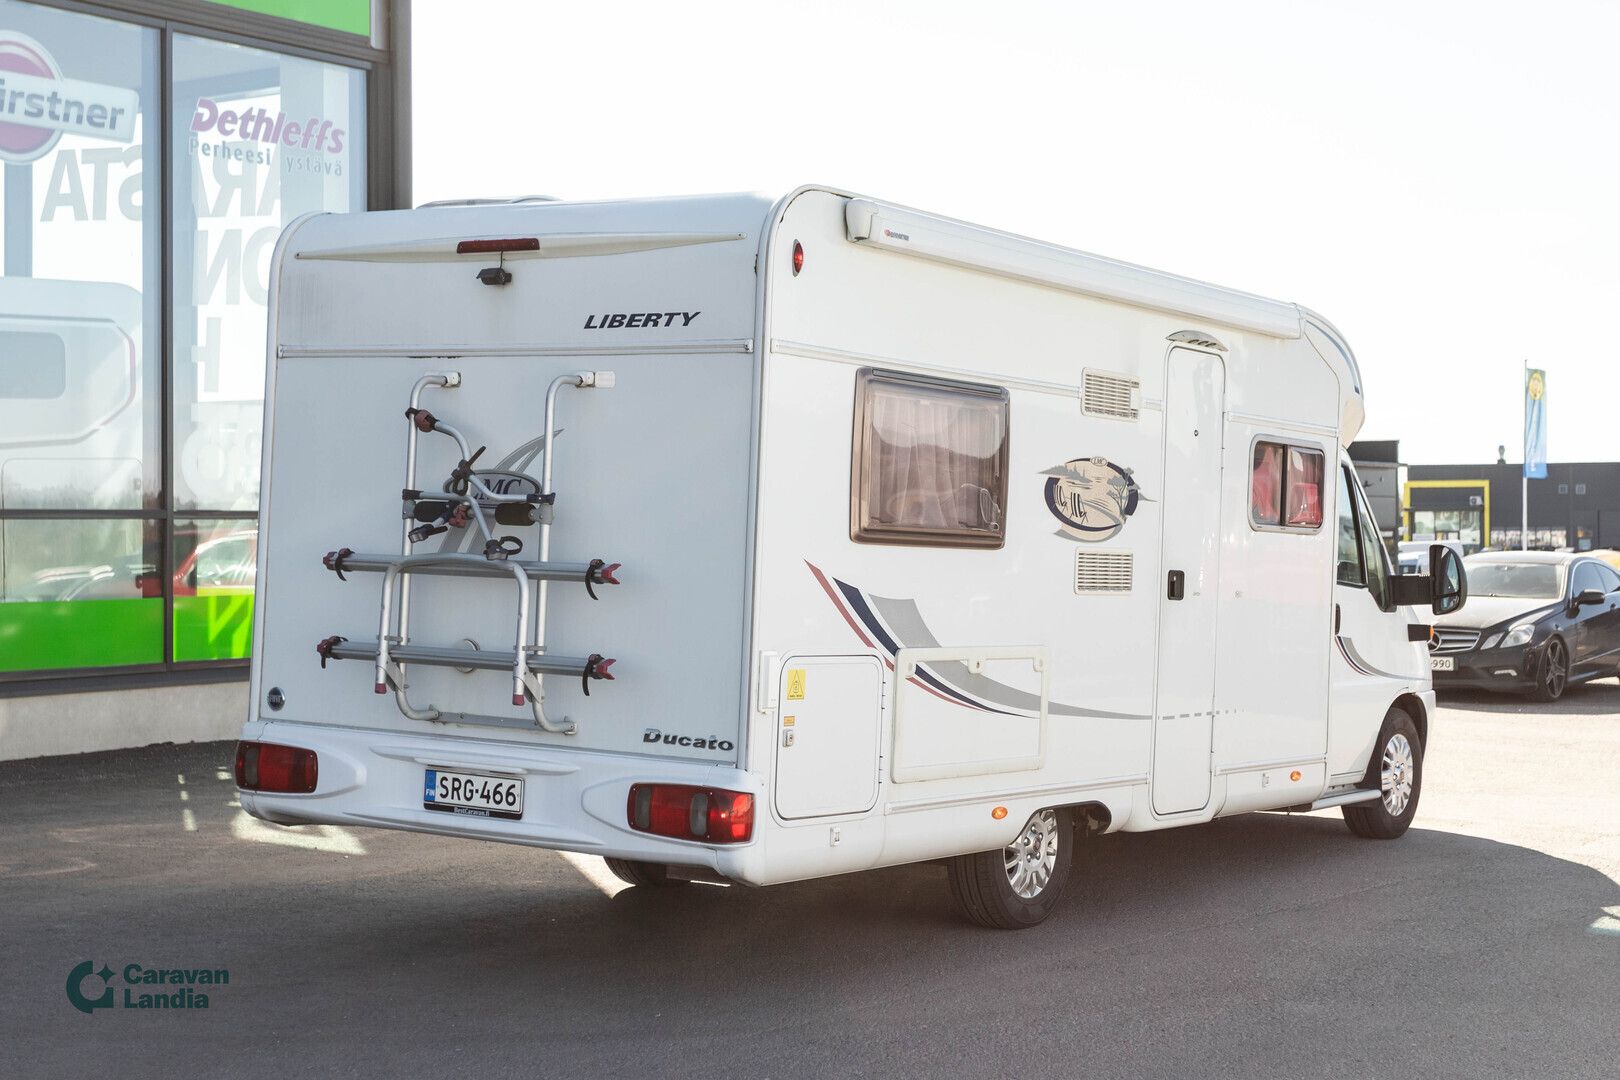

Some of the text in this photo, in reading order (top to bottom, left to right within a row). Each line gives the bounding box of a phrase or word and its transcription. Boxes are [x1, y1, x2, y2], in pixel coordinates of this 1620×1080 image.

[191, 98, 345, 154] Dethleffs
[189, 137, 343, 177] Perheesi ystävä
[583, 311, 701, 330] LIBERTY
[472, 478, 522, 500] MC
[642, 728, 735, 751] Ducato
[439, 776, 517, 807] SRG-466
